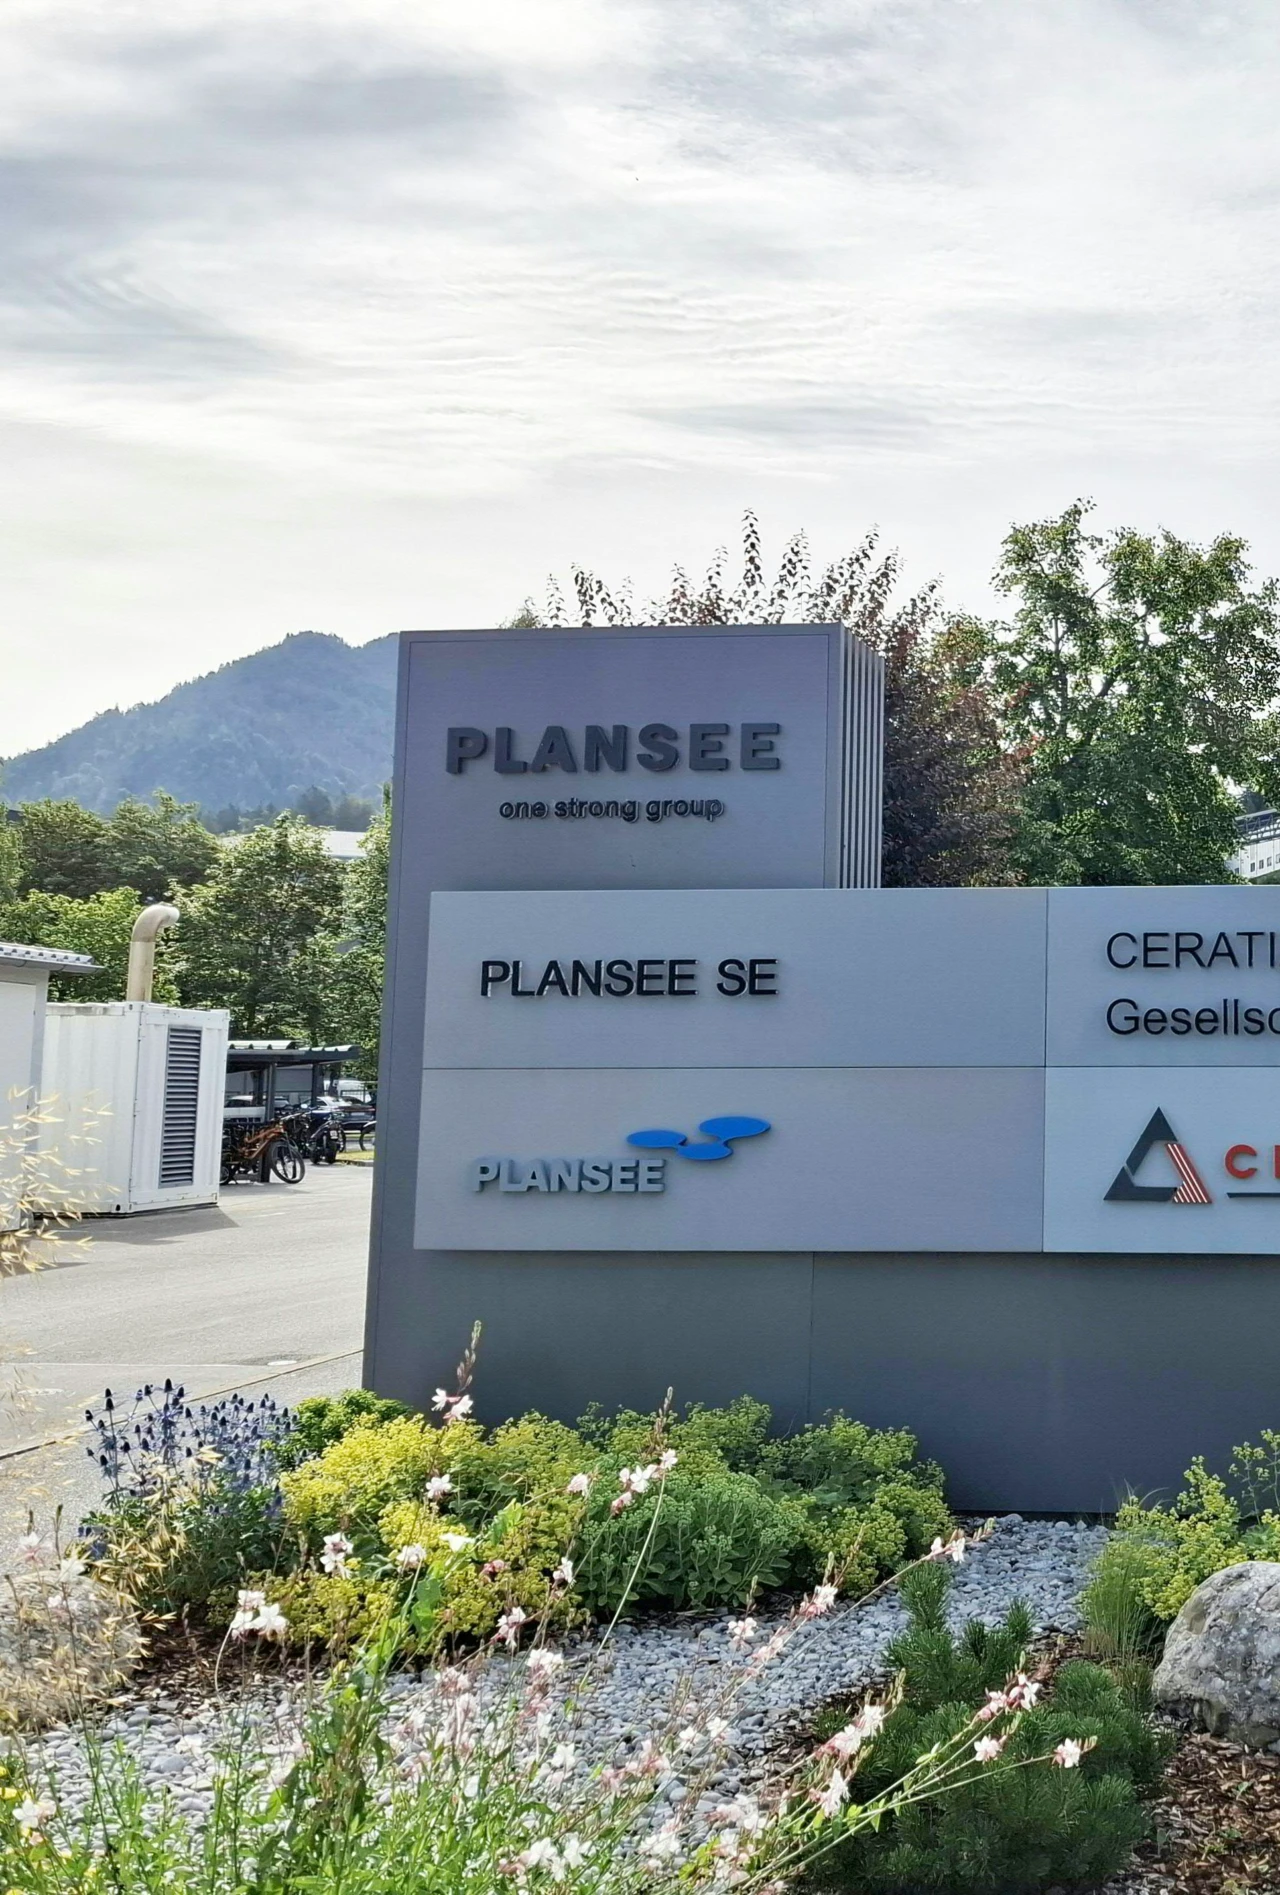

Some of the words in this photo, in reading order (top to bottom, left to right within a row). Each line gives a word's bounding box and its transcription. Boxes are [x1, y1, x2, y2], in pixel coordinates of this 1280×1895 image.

[446, 723, 781, 774] PLANSEE
[500, 800, 549, 819] one
[554, 798, 639, 823] strong
[646, 799, 725, 823] group
[480, 959, 699, 998] PLANSEE
[716, 958, 779, 997] SE
[473, 1157, 667, 1193] PLANSEE
